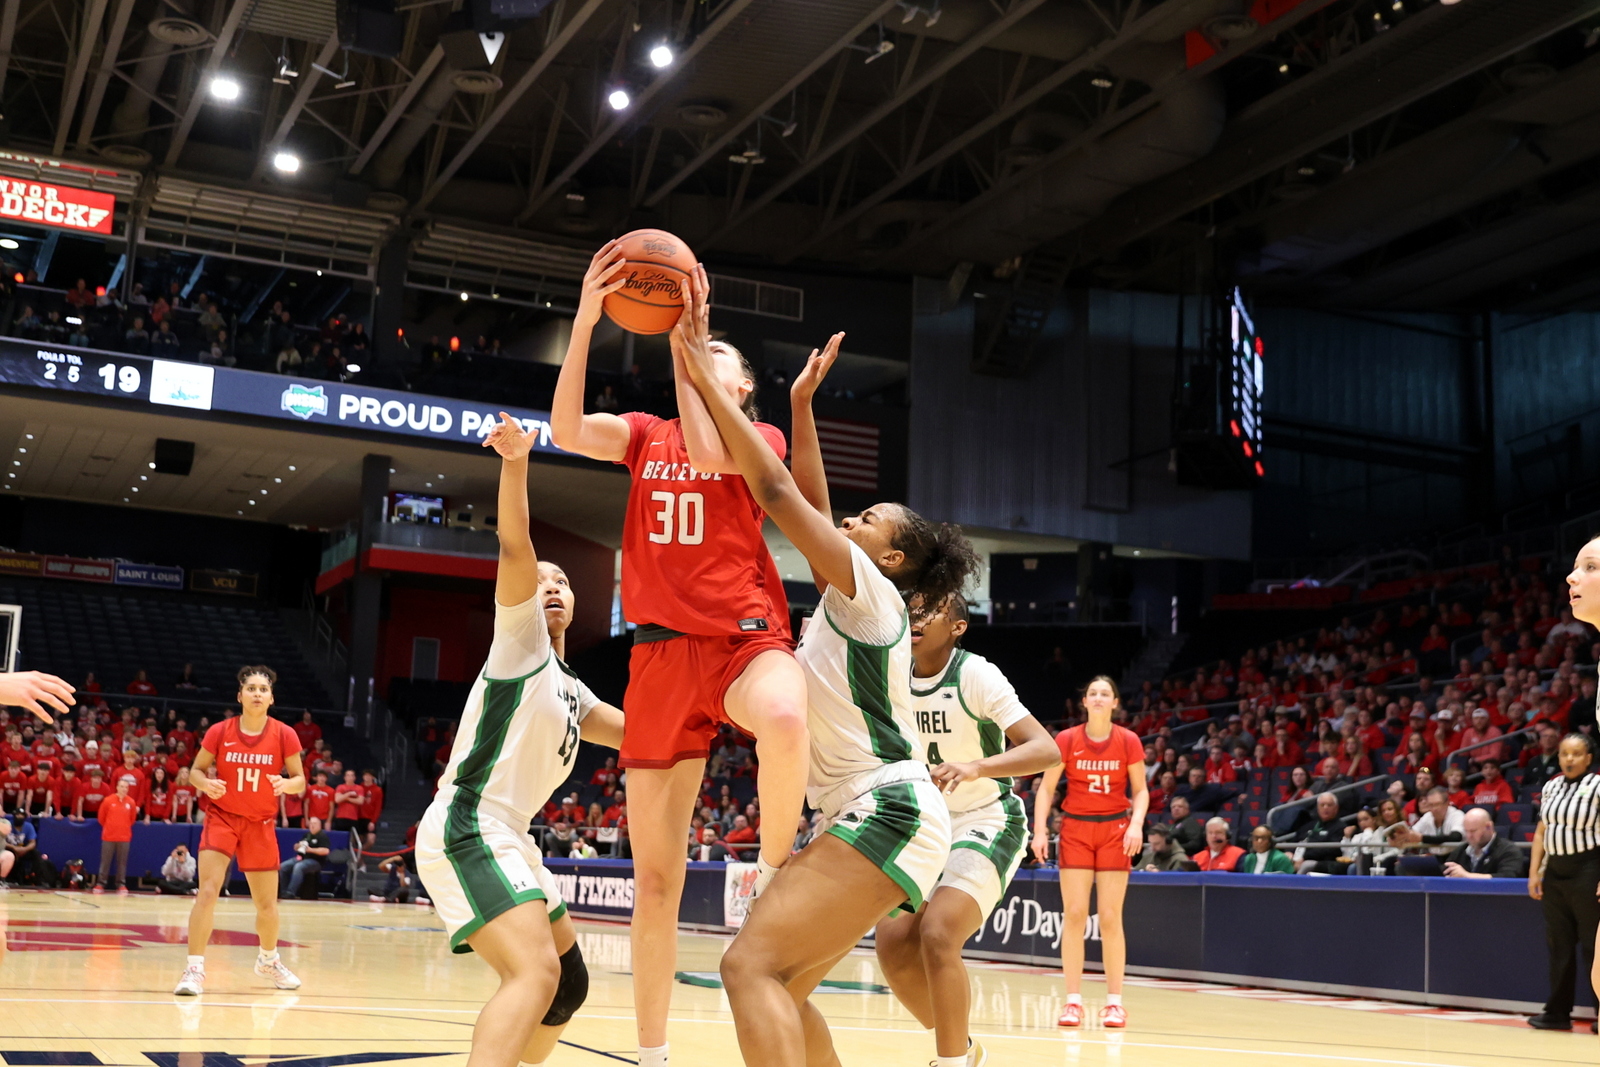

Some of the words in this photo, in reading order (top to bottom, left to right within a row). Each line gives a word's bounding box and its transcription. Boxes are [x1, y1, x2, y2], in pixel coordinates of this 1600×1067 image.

[0, 192, 89, 228] DECK
[624, 271, 683, 300] Rawling
[37, 350, 65, 363] FOULS
[44, 362, 57, 380] 2
[67, 365, 80, 383] 5
[98, 363, 141, 393] 19
[339, 394, 452, 433] PROUD
[648, 490, 704, 545] 30
[118, 568, 148, 580] SAINT
[151, 571, 181, 583] LOUIS
[212, 576, 238, 589] VCU
[225, 751, 274, 766] BELLEVUE
[1075, 759, 1121, 771] BELLEVUE
[236, 767, 261, 793] 14
[1086, 773, 1111, 795] 21
[552, 874, 577, 904] ON
[578, 875, 634, 908] FLYERS
[992, 895, 1020, 945] of
